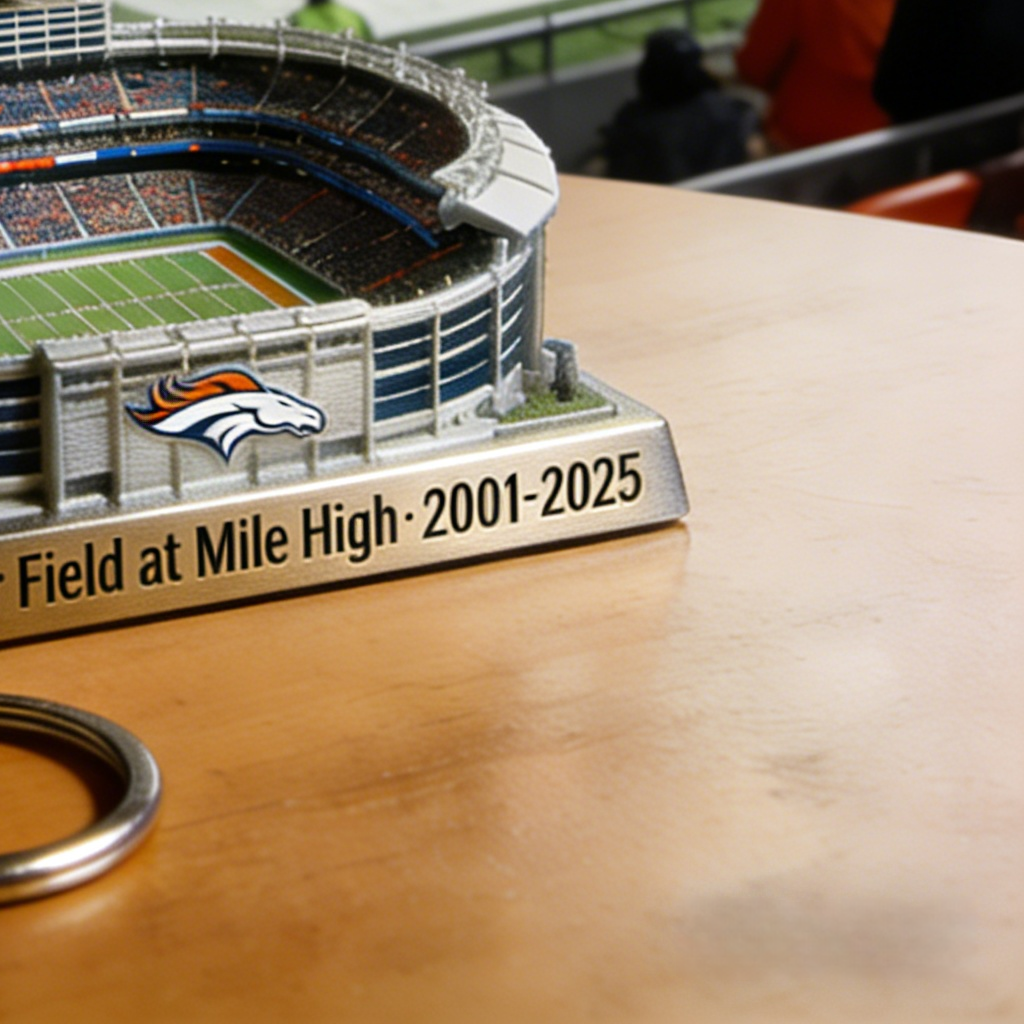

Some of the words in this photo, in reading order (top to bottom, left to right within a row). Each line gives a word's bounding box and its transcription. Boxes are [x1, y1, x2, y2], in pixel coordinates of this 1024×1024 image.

[18, 537, 124, 609] Field
[139, 533, 182, 587] at
[196, 514, 288, 578] Mile
[422, 451, 642, 539] 2001-2025
